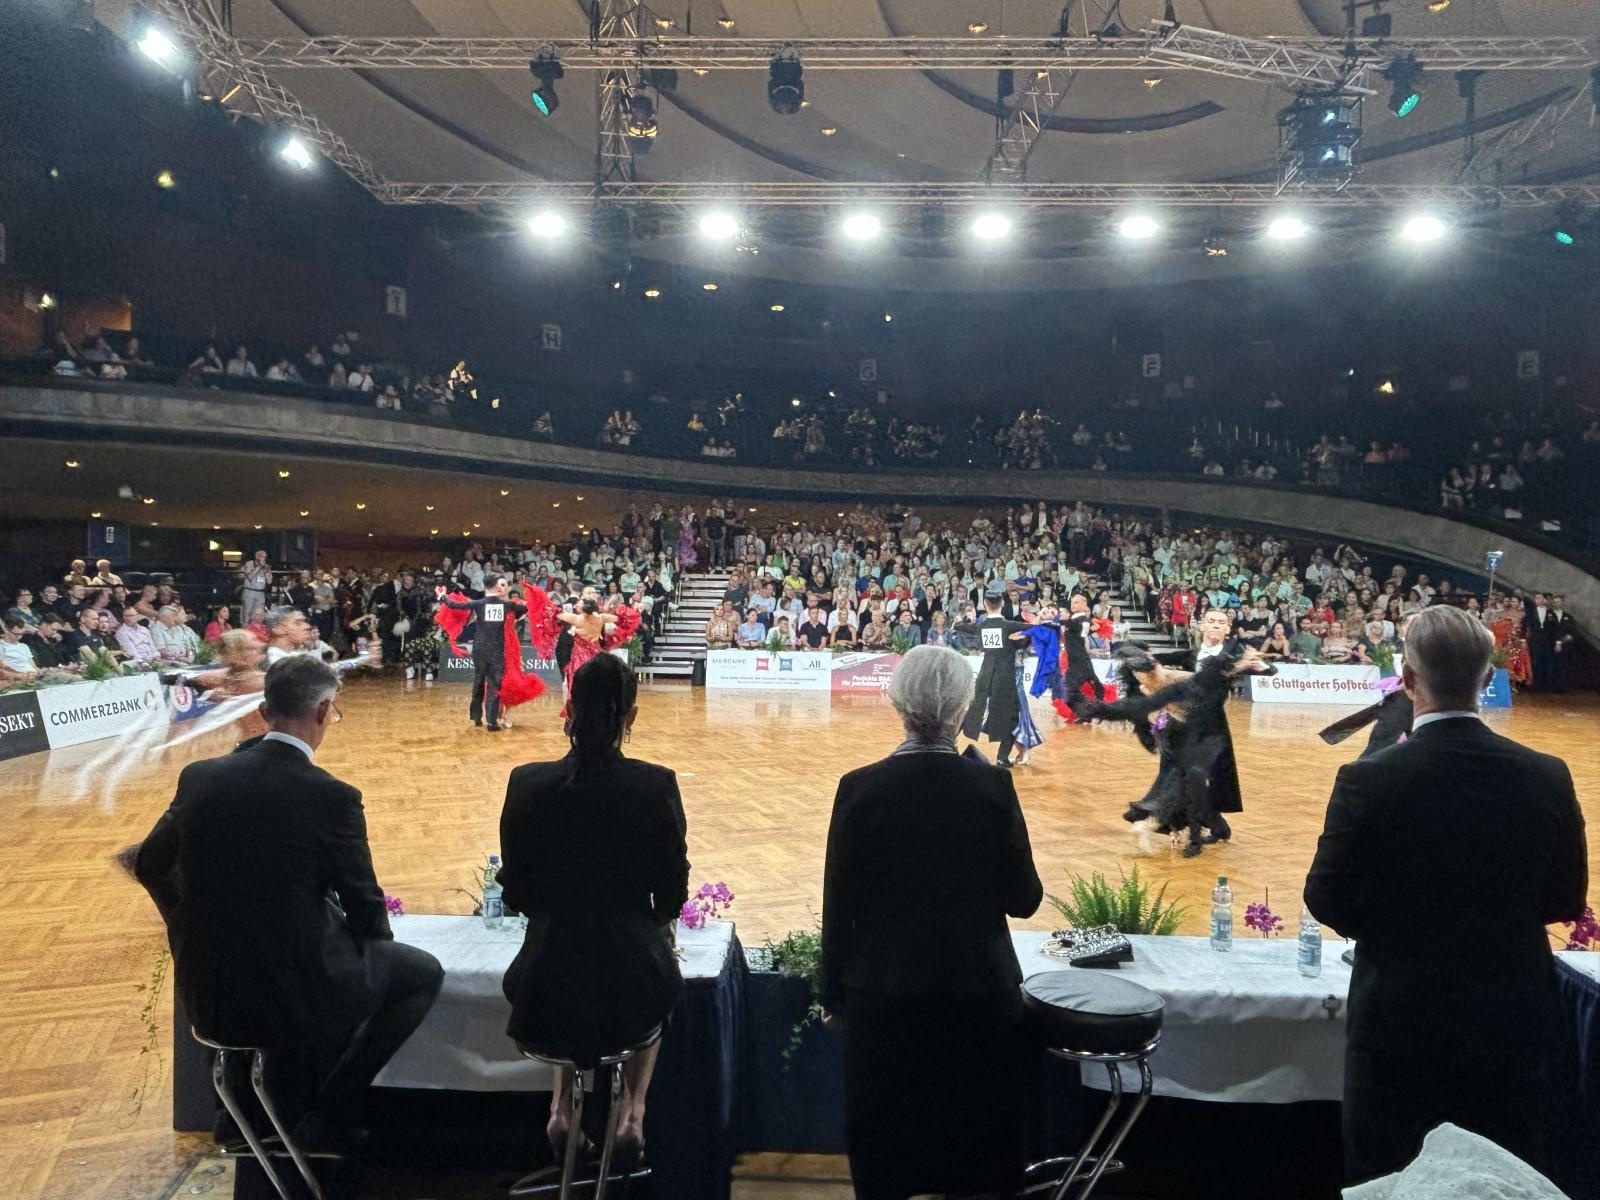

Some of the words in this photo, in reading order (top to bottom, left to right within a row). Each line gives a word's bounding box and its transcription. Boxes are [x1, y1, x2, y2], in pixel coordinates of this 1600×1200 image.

[1147, 362, 1157, 375] F
[487, 609, 503, 619] 178
[983, 634, 1001, 646] 242
[526, 659, 556, 670] SEKT
[1272, 678, 1330, 691] Stuttgarter
[50, 698, 142, 727] COMMERZBANK
[0, 712, 35, 734] SEKT
